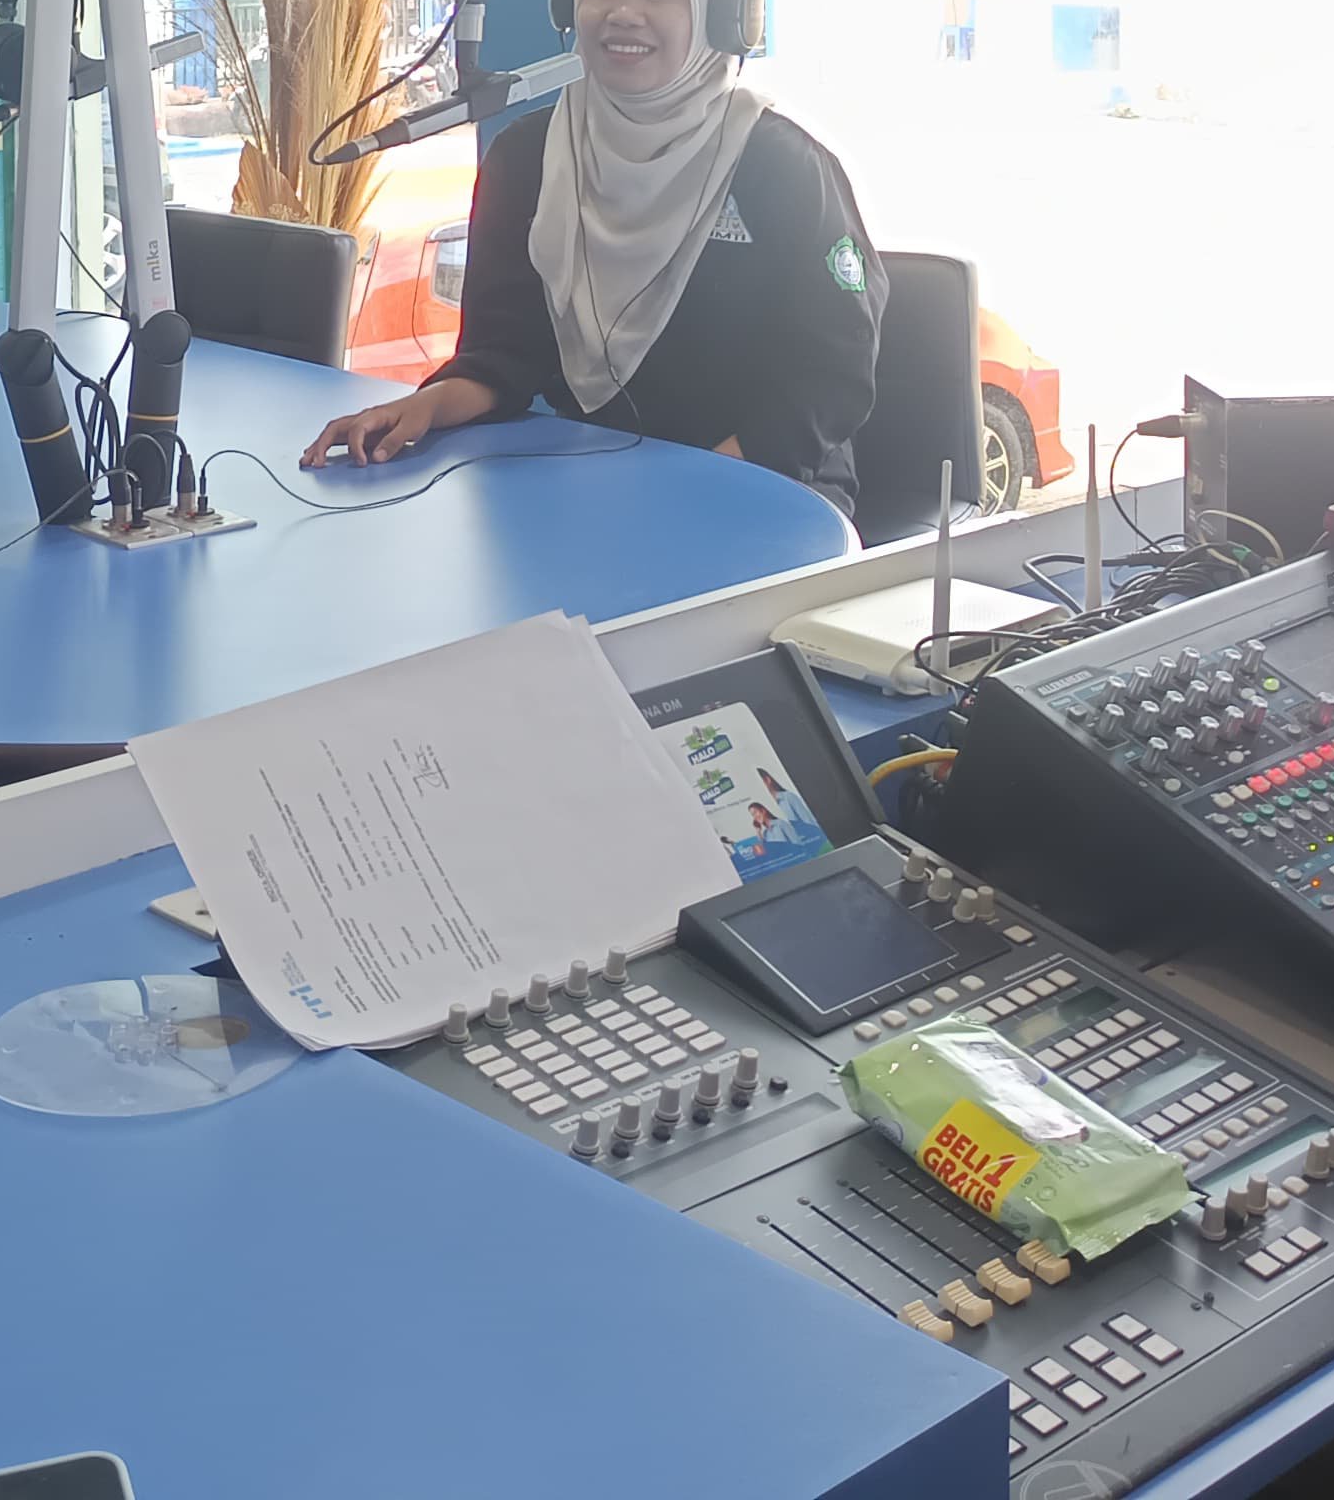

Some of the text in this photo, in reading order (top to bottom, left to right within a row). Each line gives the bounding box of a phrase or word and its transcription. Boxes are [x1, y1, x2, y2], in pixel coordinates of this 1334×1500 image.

[147, 240, 162, 281] mika
[922, 1146, 997, 1215] GRATIS
[935, 1123, 992, 1174] BELI
[983, 1150, 1017, 1189] 1
